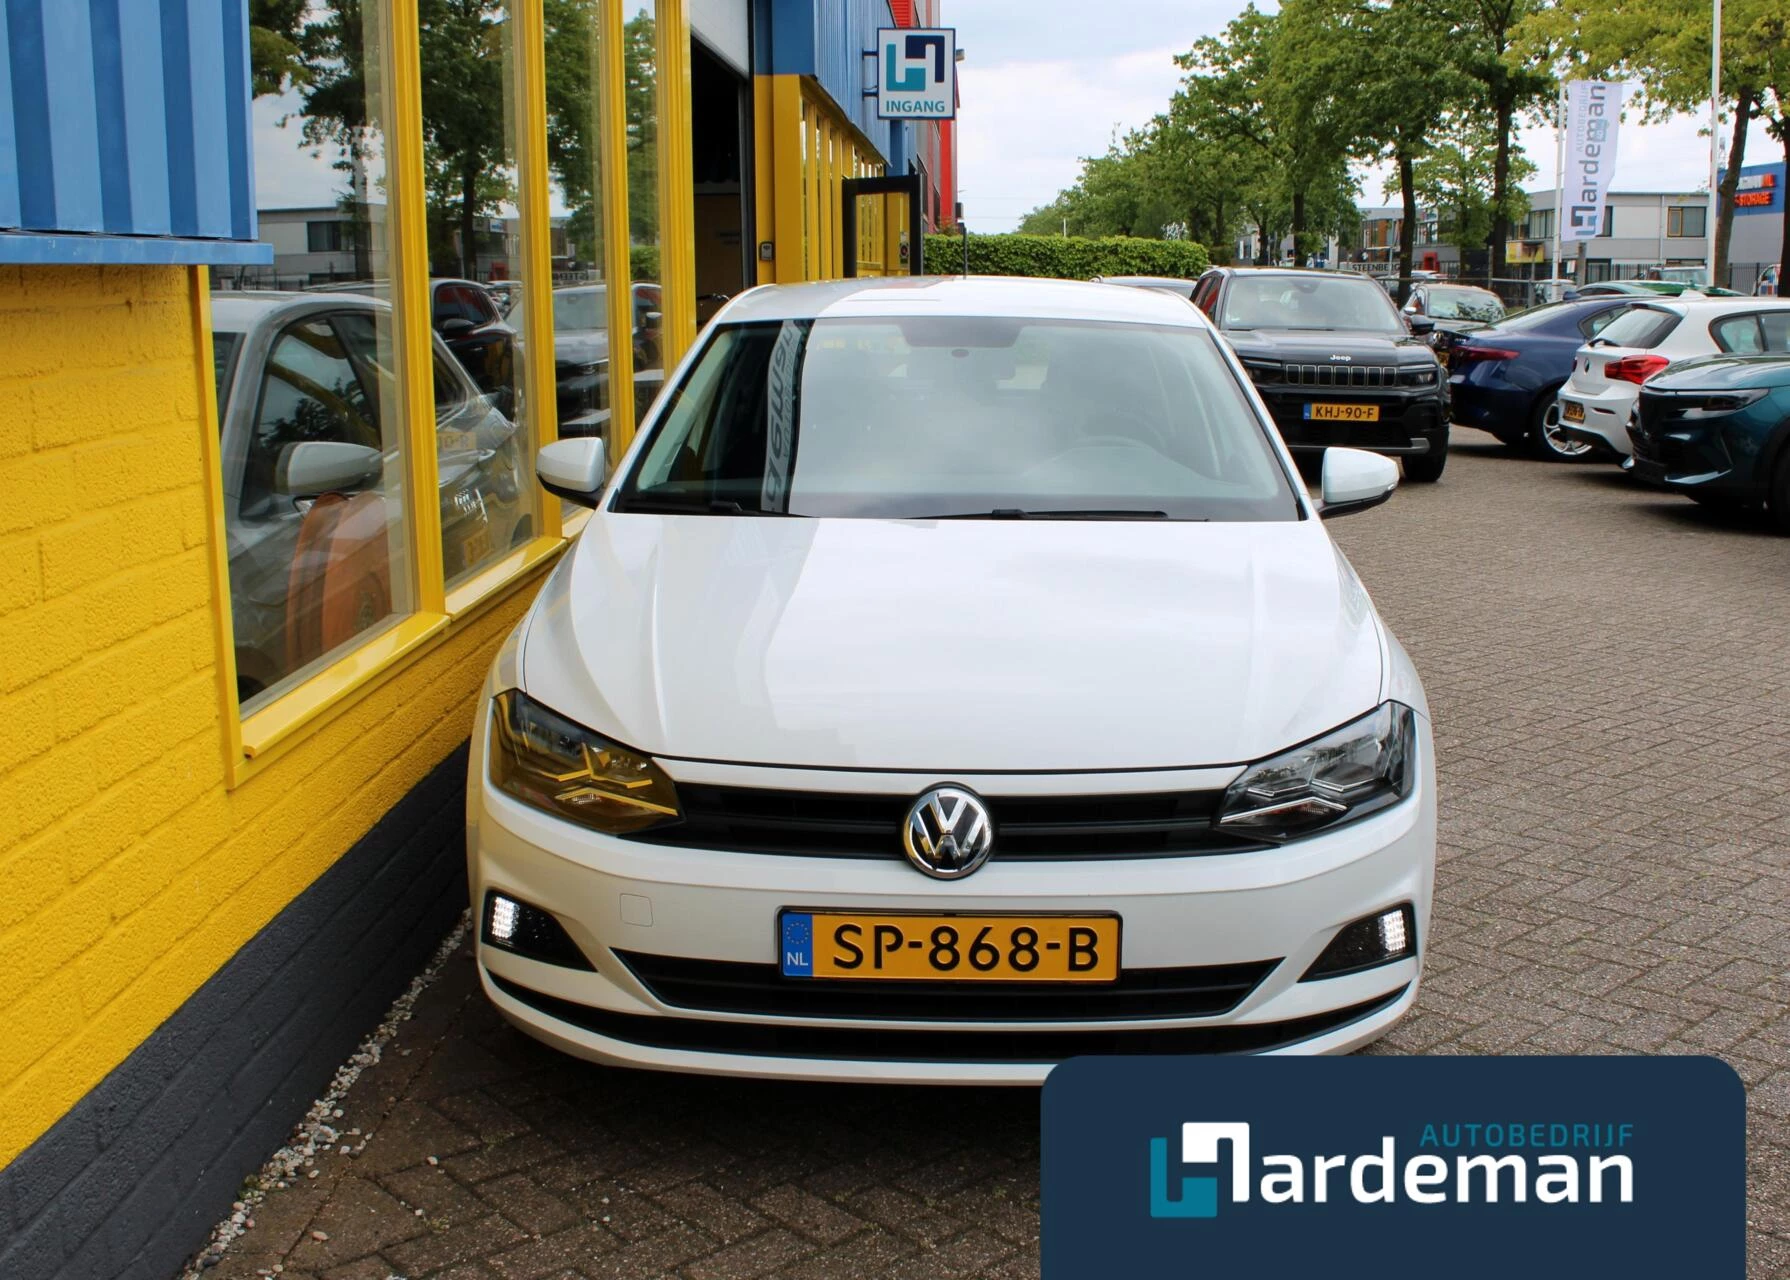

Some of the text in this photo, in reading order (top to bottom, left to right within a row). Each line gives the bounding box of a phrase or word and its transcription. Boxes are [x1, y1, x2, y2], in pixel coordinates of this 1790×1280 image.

[886, 100, 945, 112] INGANG
[1571, 85, 1606, 236] Hardeman
[1315, 406, 1374, 418] KHJ-90-F
[833, 923, 1099, 972] SP-868-B
[787, 952, 808, 967] NL
